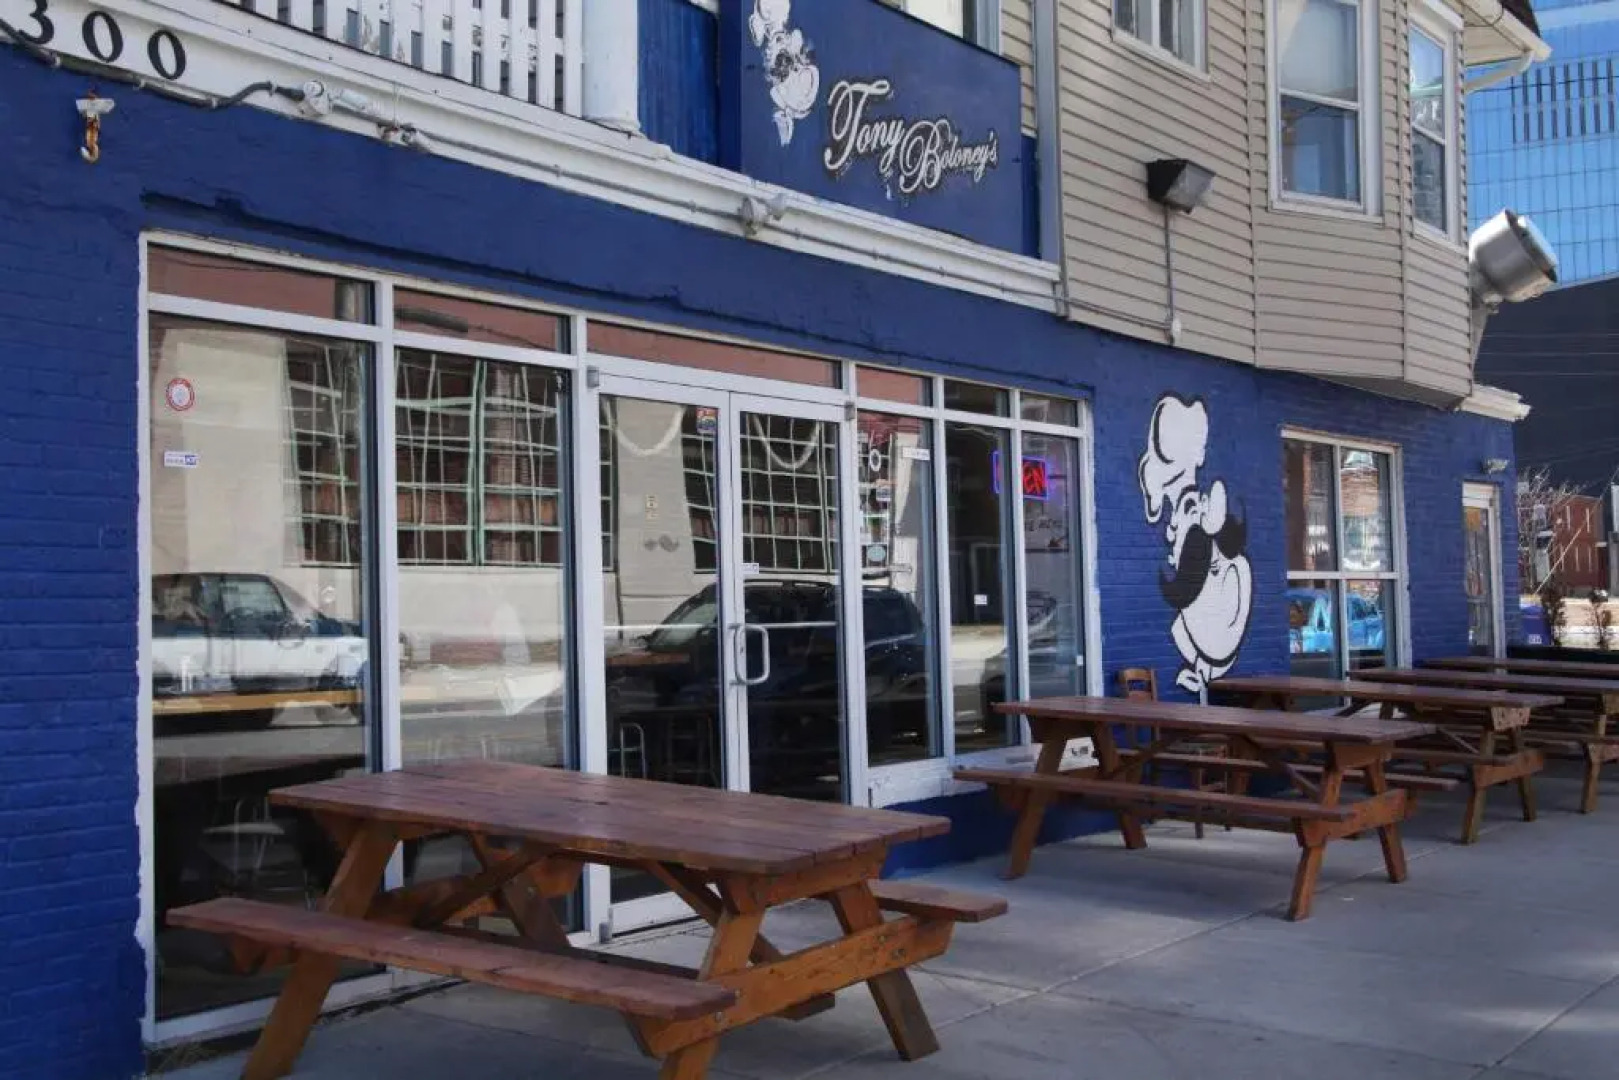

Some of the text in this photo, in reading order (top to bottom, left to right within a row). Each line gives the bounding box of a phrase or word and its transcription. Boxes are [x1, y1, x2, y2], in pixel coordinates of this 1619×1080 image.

[17, 0, 187, 80] 300
[824, 80, 998, 193] Tony Boloney's
